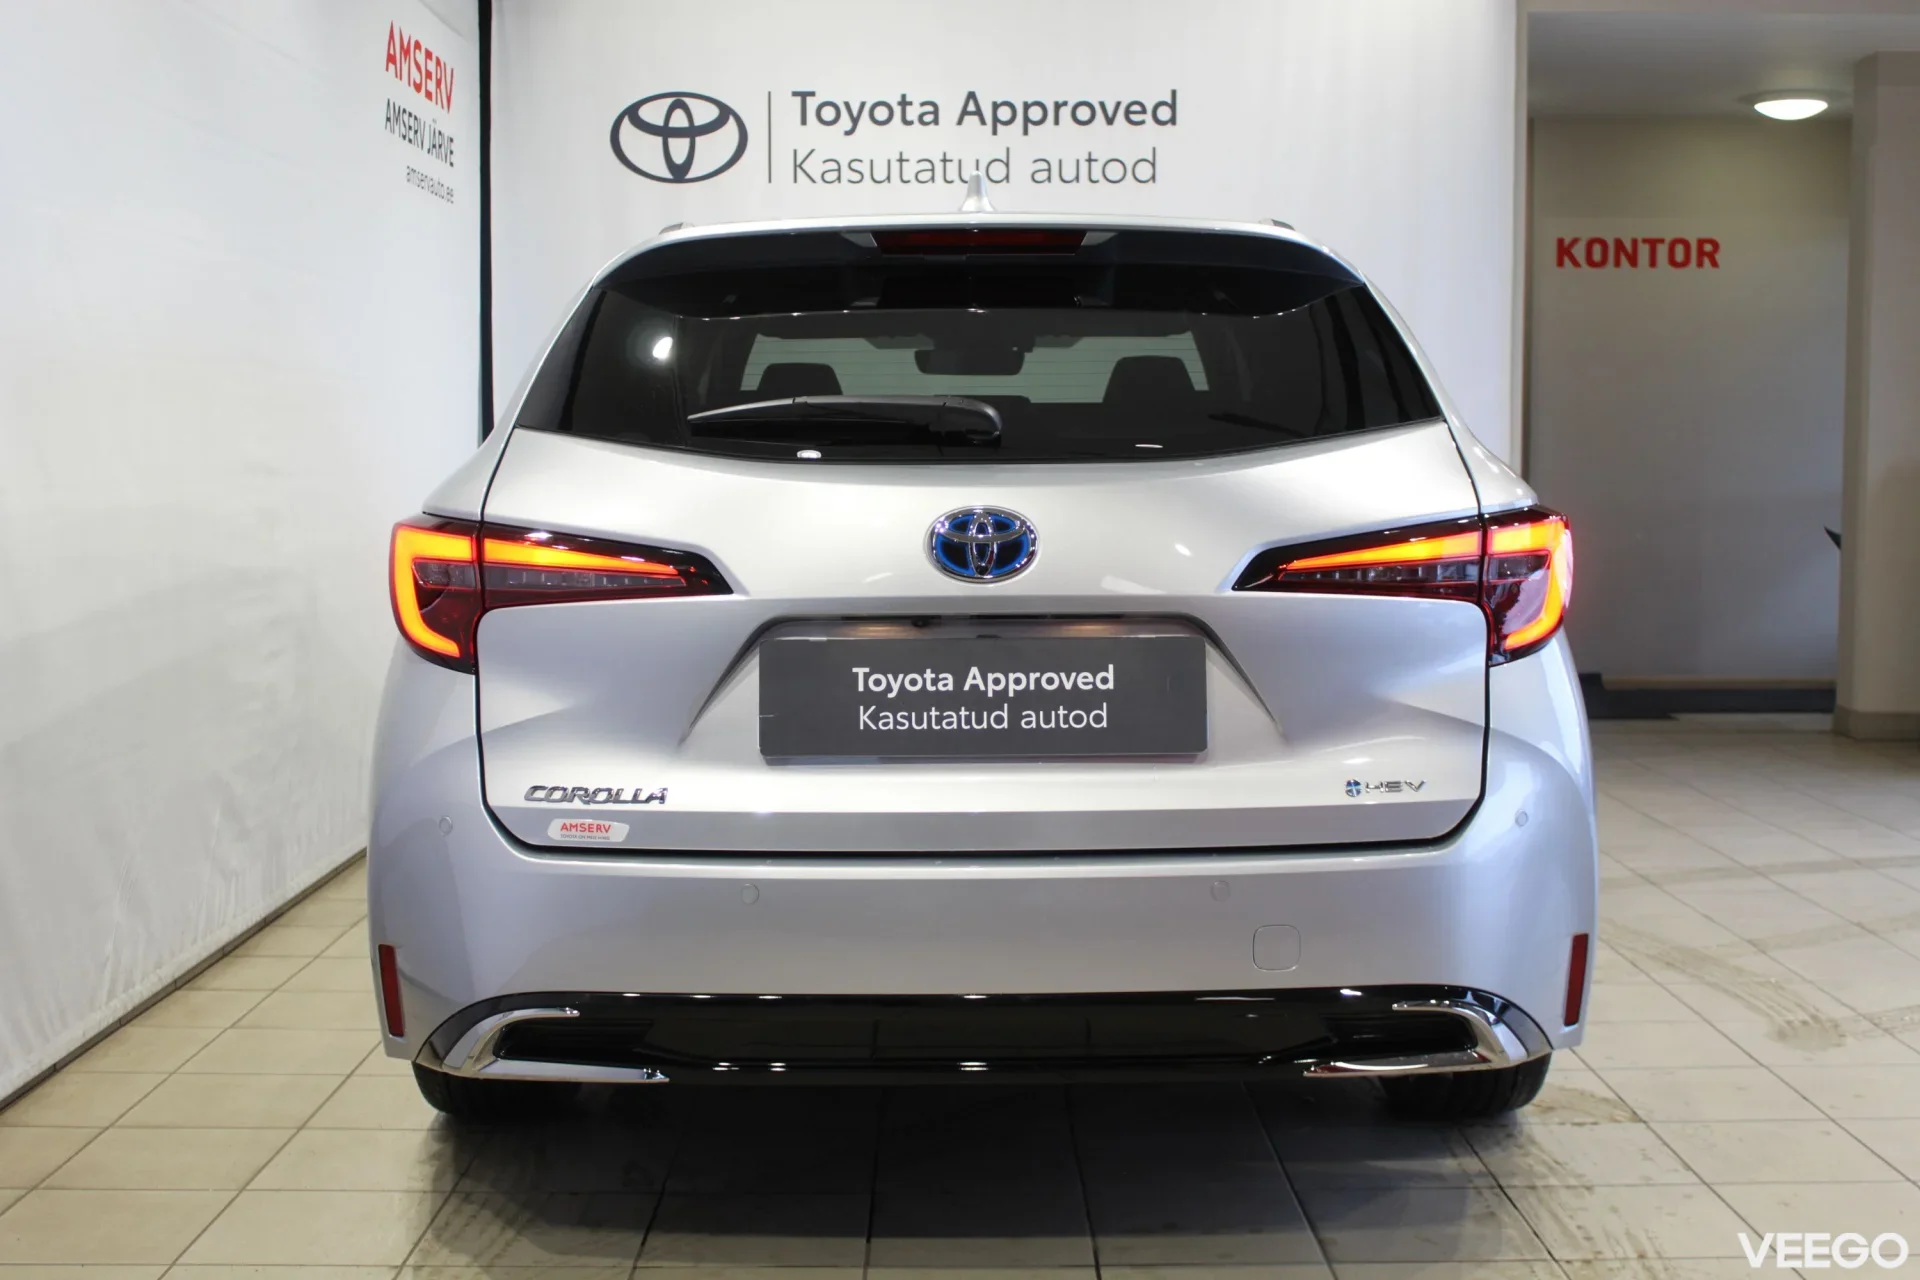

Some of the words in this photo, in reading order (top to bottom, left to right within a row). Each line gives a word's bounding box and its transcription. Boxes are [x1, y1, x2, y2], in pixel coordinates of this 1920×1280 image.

[385, 20, 454, 114] AMSERV
[791, 90, 940, 135] Toyota
[956, 89, 1178, 136] Approved
[385, 98, 426, 151] AMSERV
[426, 118, 454, 167] JÄRVE
[792, 147, 1011, 184] Kasutatud
[1030, 147, 1157, 184] autod
[406, 165, 454, 204] amservauto.ee
[1556, 237, 1721, 269] KONTOR
[852, 667, 954, 697] Toyota
[963, 664, 1115, 697] Approved
[859, 703, 1009, 730] Kasutatud
[1020, 702, 1107, 729] autod
[524, 785, 668, 805] COROLLA
[1365, 780, 1427, 794] HEV
[560, 822, 611, 833] AMSERV
